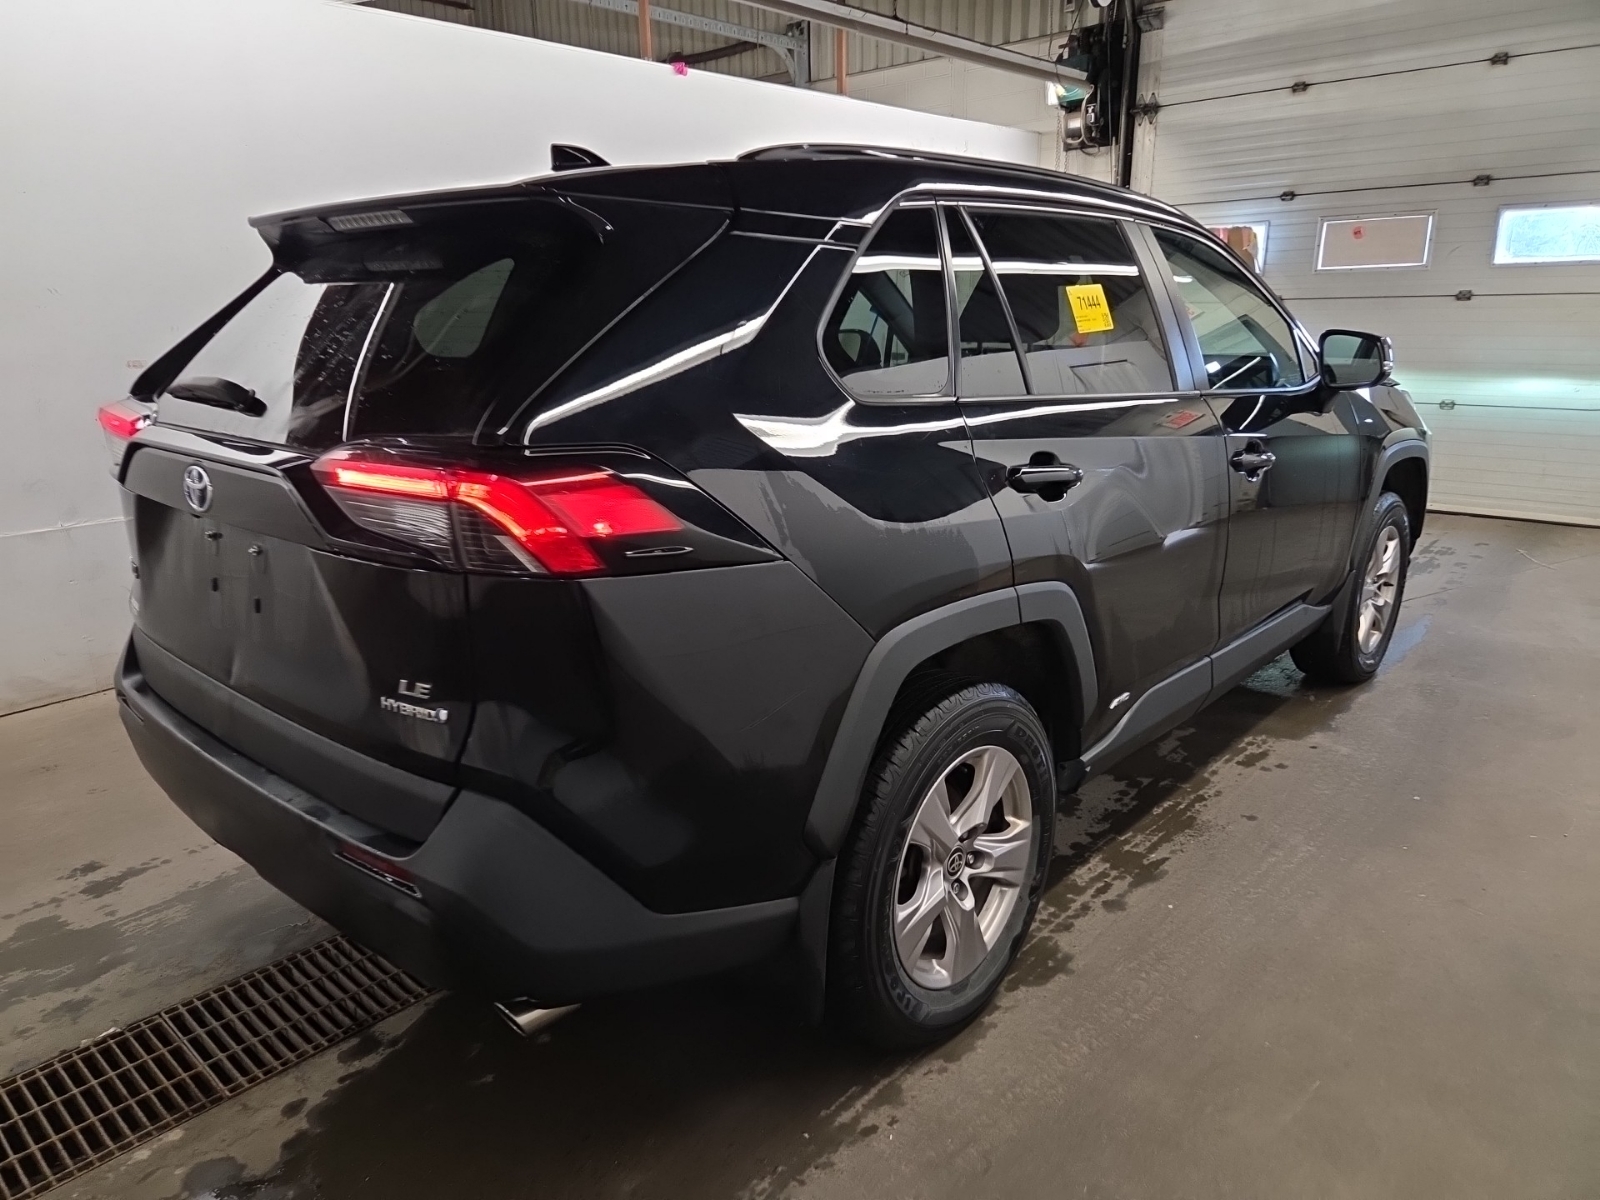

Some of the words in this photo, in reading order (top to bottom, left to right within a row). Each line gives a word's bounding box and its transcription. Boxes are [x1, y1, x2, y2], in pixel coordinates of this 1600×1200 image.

[1076, 295, 1102, 310] 71444
[398, 679, 433, 699] LE
[380, 696, 438, 722] HYBRID
